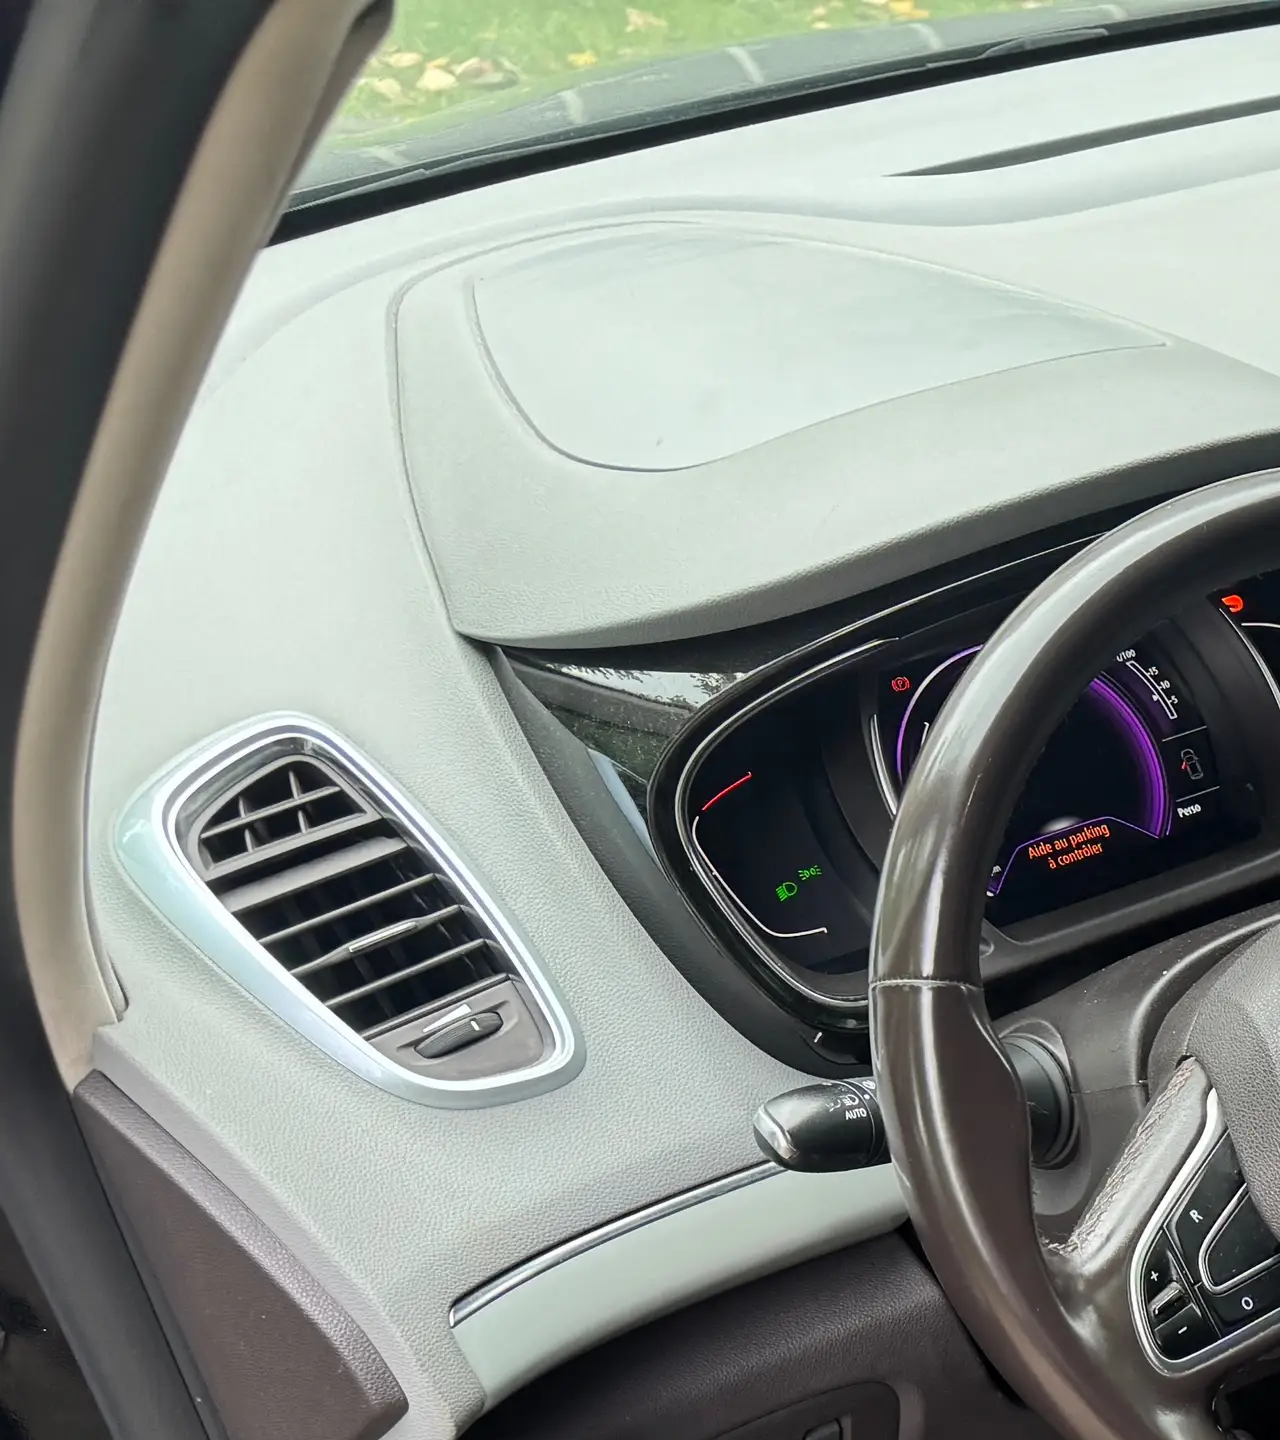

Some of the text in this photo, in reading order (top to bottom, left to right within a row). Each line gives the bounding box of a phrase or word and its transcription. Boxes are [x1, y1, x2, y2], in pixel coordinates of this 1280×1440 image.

[1148, 666, 1159, 676] 15
[1160, 680, 1171, 690] 10
[1171, 695, 1179, 704] 5
[1177, 803, 1202, 819] Perso
[1028, 823, 1110, 860] Aide au parking
[1048, 842, 1104, 870] à contrôler
[845, 1107, 867, 1121] AUTO
[1189, 1209, 1204, 1224] R
